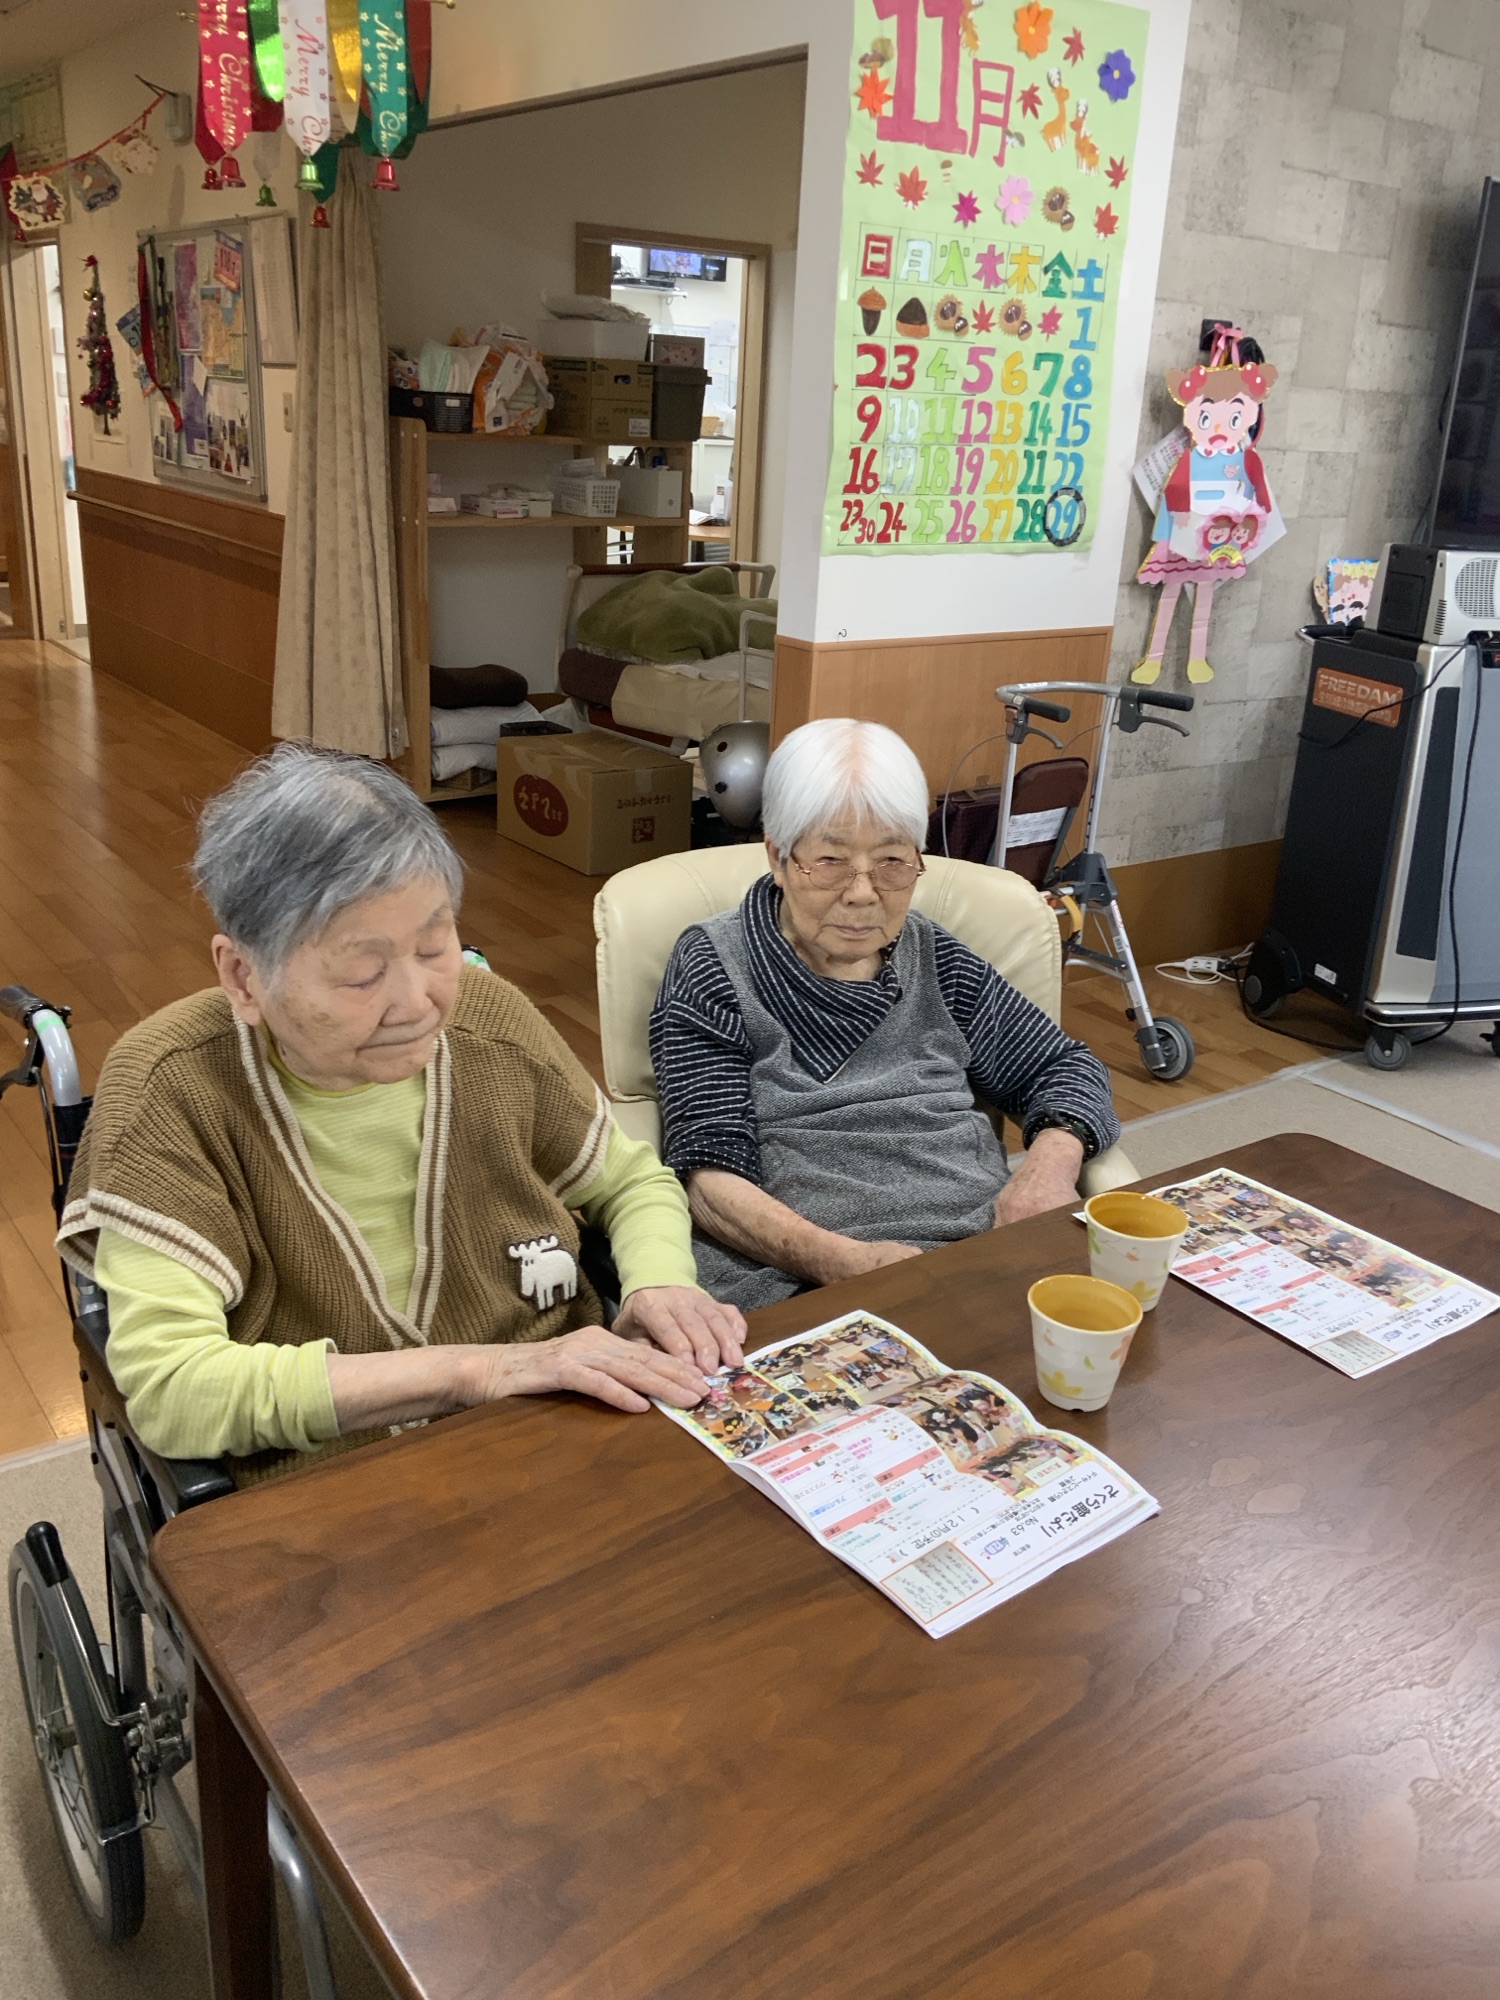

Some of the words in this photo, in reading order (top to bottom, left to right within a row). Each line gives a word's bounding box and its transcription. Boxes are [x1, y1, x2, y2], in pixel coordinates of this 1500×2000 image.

[291, 19, 320, 97] Merry
[370, 13, 400, 93] Merry
[862, 234, 893, 278] 日
[899, 239, 932, 283] 月
[934, 240, 970, 287] 火
[972, 244, 1007, 289] 水
[1006, 246, 1041, 294] 木
[1043, 251, 1074, 298] 金
[1072, 259, 1104, 302] 土
[1069, 306, 1096, 351] 1
[855, 343, 887, 389] 2
[889, 344, 919, 389] 3
[926, 348, 956, 391] 4
[961, 346, 996, 393] 5
[1001, 351, 1027, 395] 6
[1033, 352, 1064, 397] 7
[1063, 354, 1092, 400] 8
[856, 394, 882, 443] 9
[886, 396, 920, 443] 10
[921, 397, 957, 443] 11
[957, 398, 993, 444] 12
[992, 400, 1023, 443] 13
[1024, 401, 1052, 446] 14
[1055, 400, 1092, 447] 15
[842, 446, 880, 494] 16
[880, 447, 917, 494] 17
[915, 446, 950, 495] 18
[950, 447, 984, 494] 19
[983, 448, 1019, 494] 20
[1017, 450, 1047, 494] 21
[1051, 451, 1085, 493] 22
[840, 499, 864, 531] 23
[854, 517, 876, 544] 30
[877, 501, 907, 543] 24
[911, 500, 944, 543] 25
[946, 499, 977, 543] 26
[979, 499, 1014, 542] 27
[1013, 499, 1046, 541] 28
[1050, 499, 1077, 538] 29
[1318, 674, 1397, 705] FREEDAM
[1010, 1516, 1040, 1535] No.63
[1041, 1484, 1120, 1538] さくら館だより
